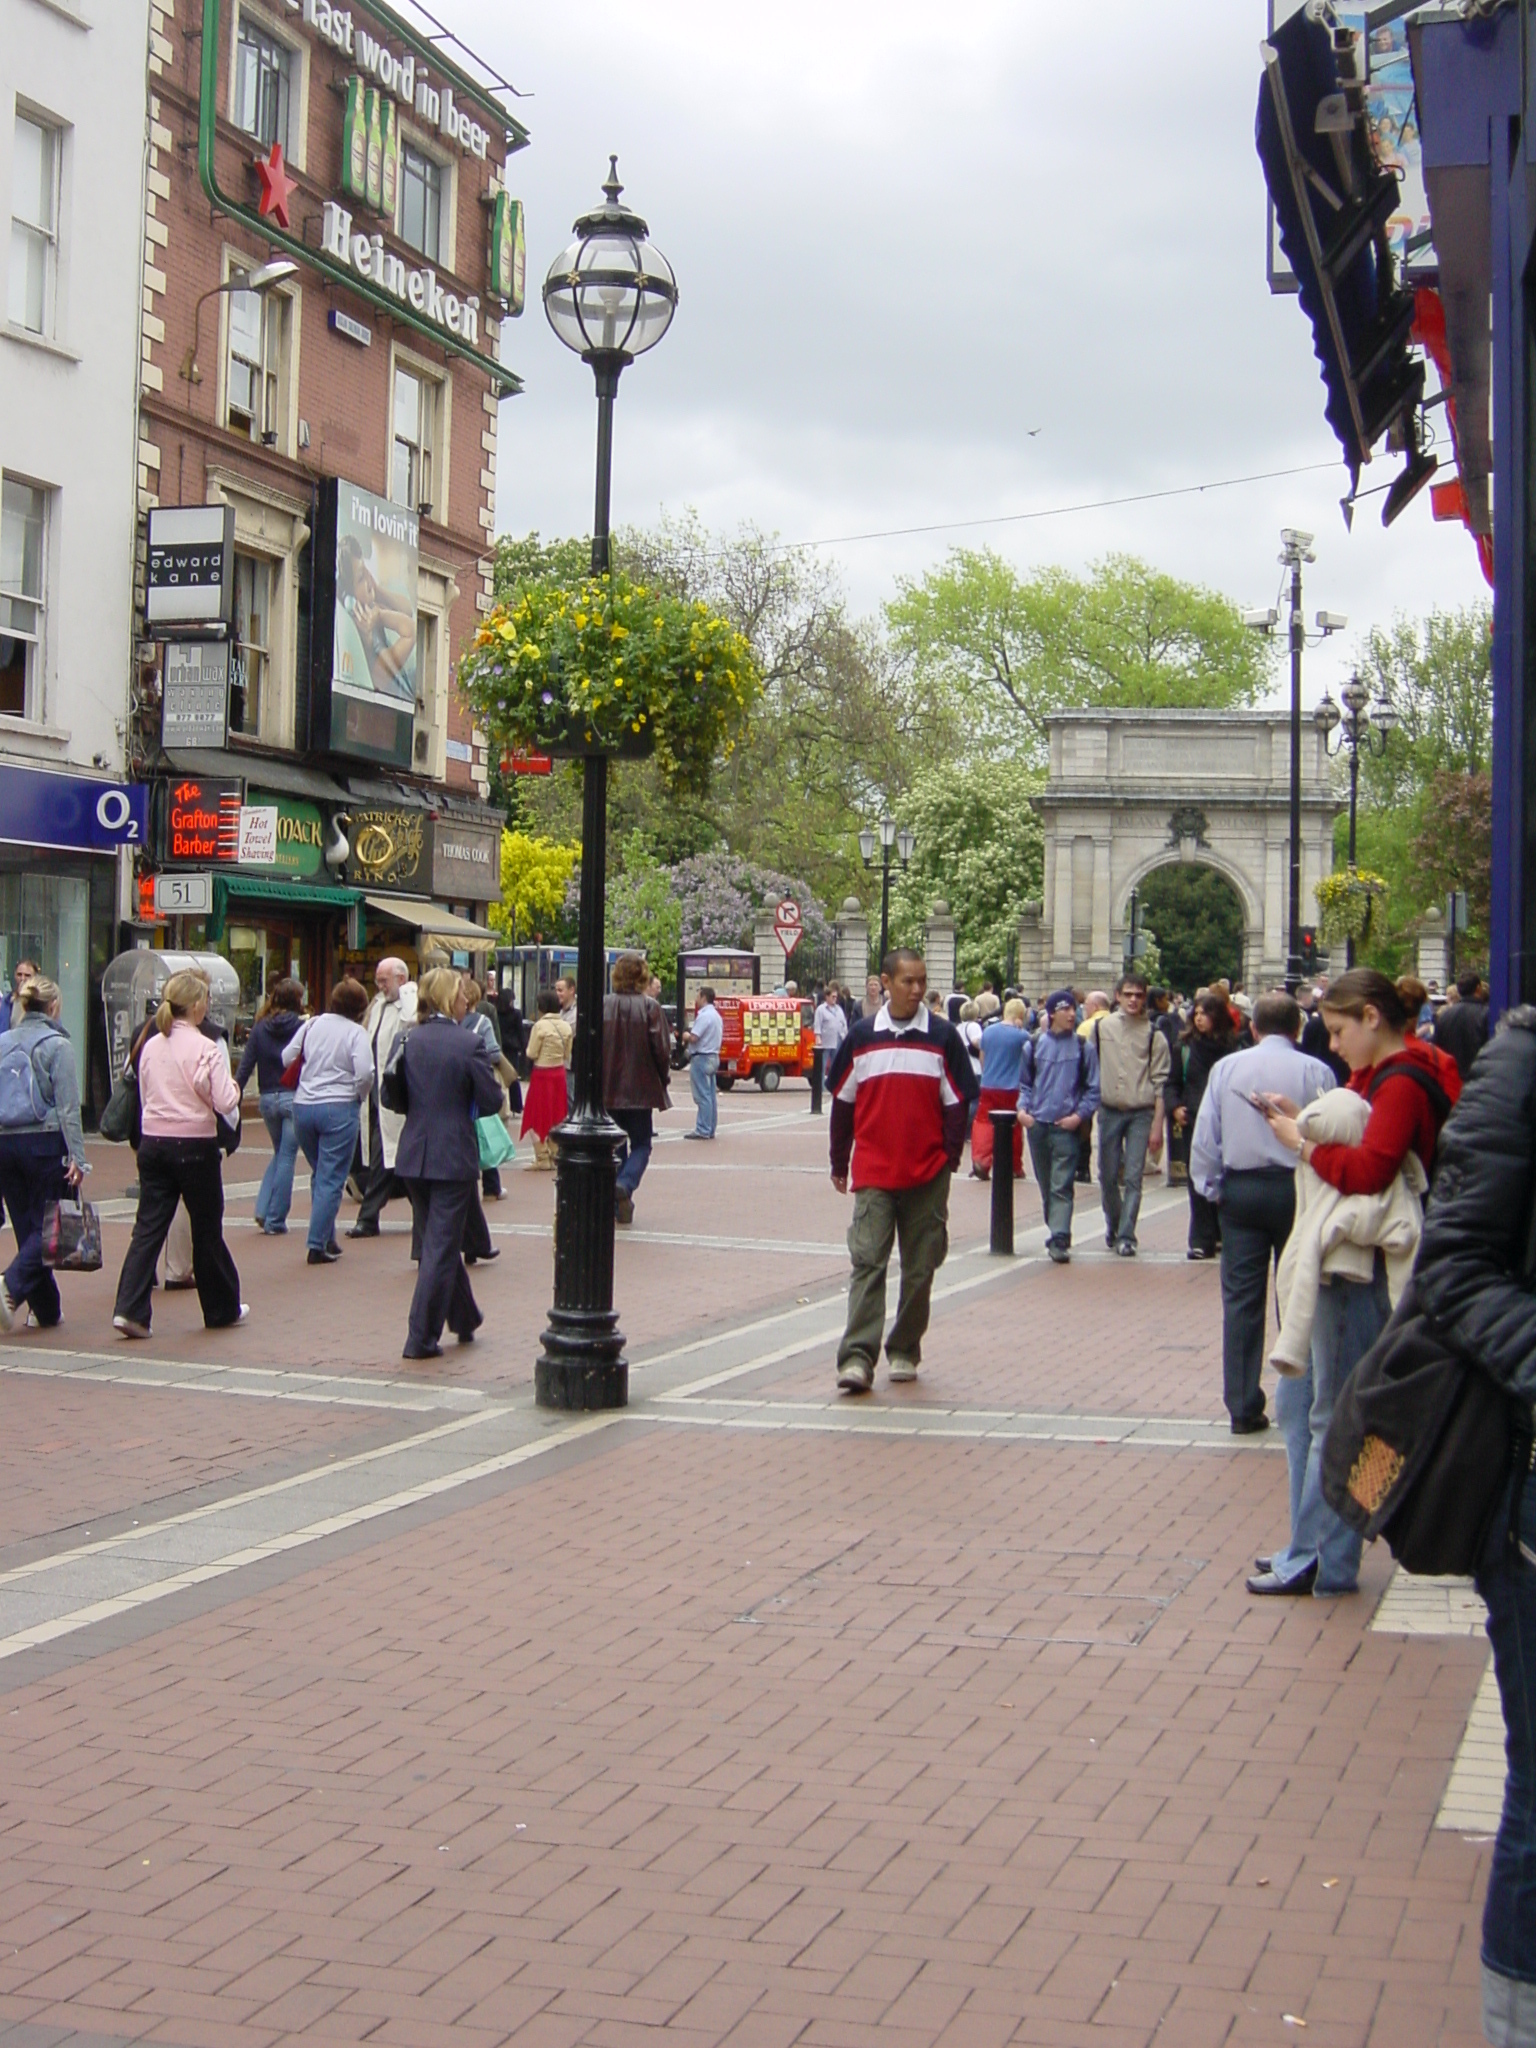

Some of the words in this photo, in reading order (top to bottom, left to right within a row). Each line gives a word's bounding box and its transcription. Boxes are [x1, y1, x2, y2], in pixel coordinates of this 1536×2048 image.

[355, 30, 415, 104] word
[415, 67, 439, 125] in
[440, 88, 491, 161] beer
[321, 201, 481, 345] Heineken
[150, 553, 221, 569] edward
[150, 571, 220, 584] kane
[202, 666, 224, 682] wax
[174, 780, 202, 805] The
[171, 807, 218, 830] Grafton
[249, 816, 268, 830] Hot
[173, 832, 217, 855] Barber
[244, 831, 273, 845] Towel
[240, 846, 275, 862] Shaving
[442, 843, 471, 861] THOMAS
[471, 848, 490, 864] COOK
[171, 882, 192, 905] 51
